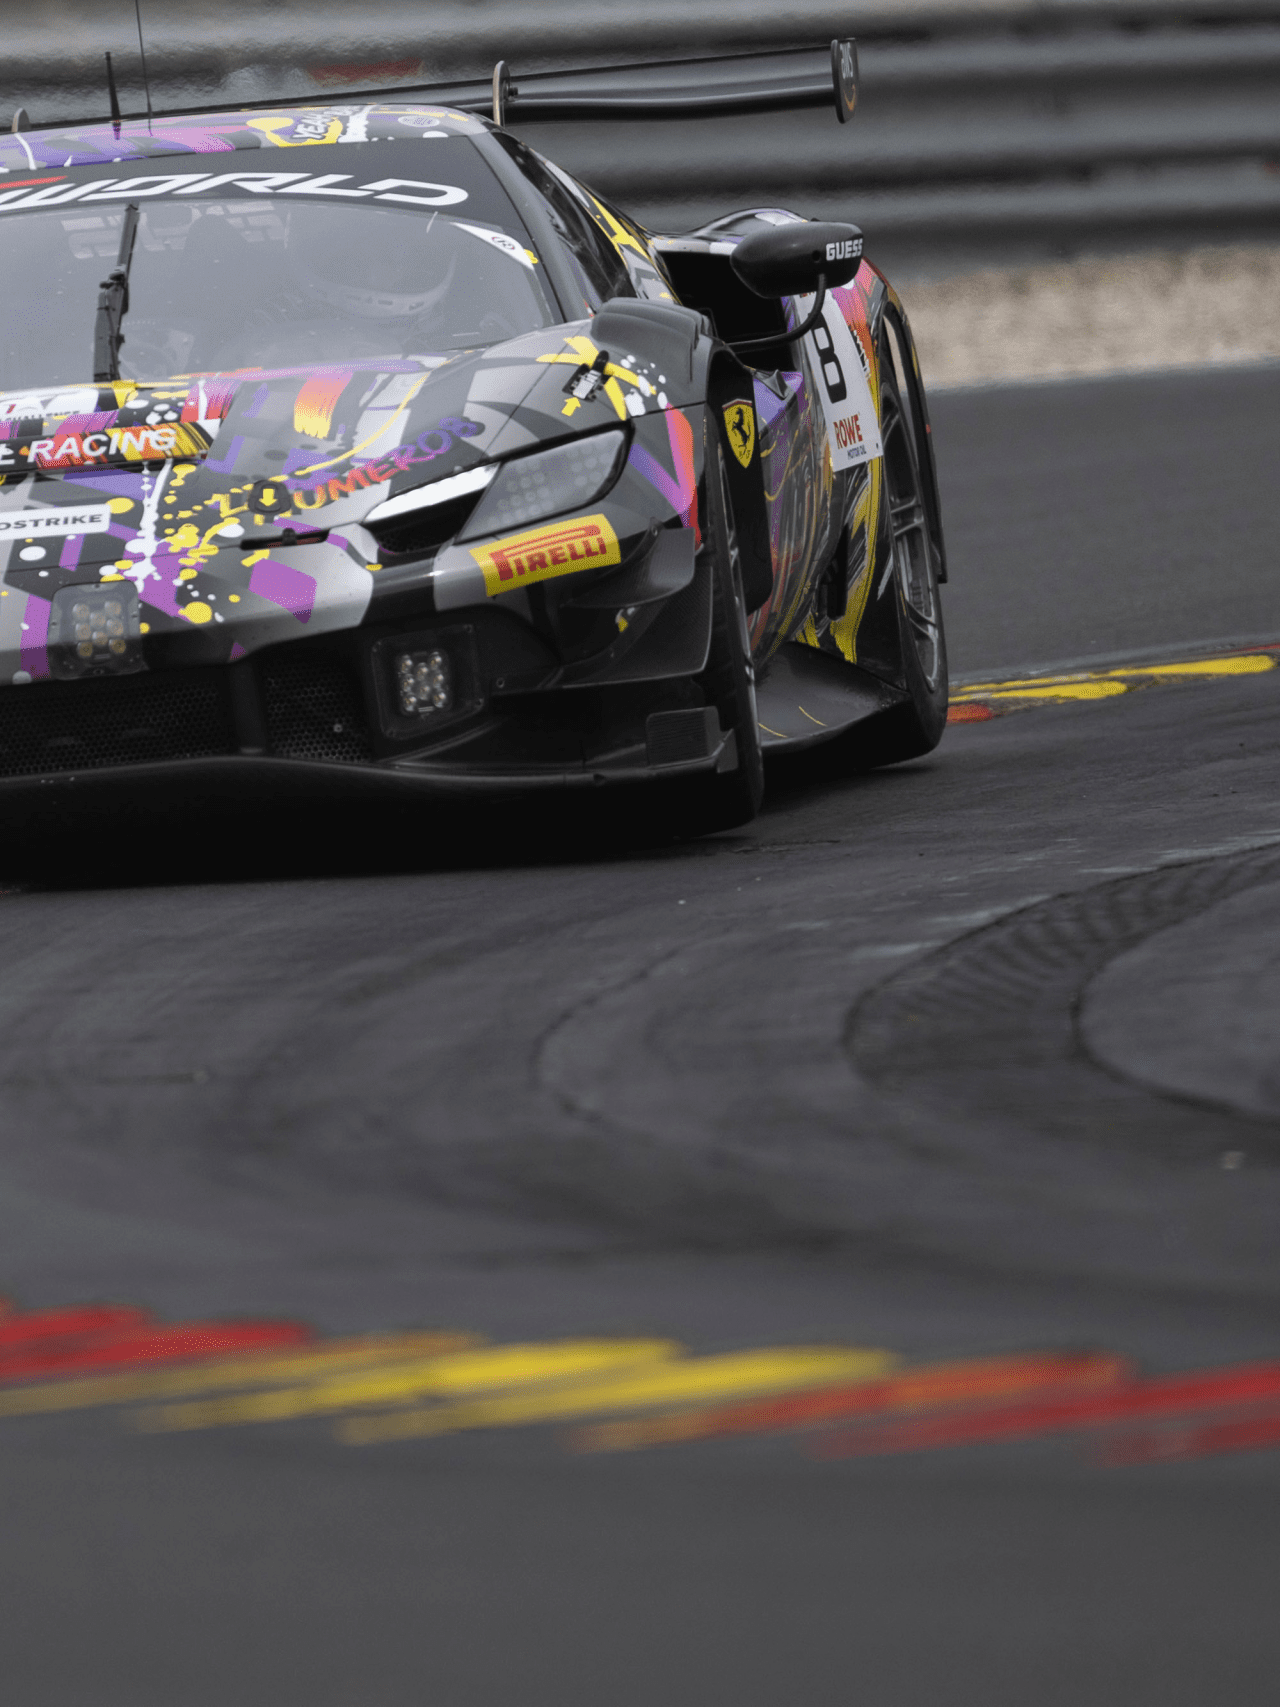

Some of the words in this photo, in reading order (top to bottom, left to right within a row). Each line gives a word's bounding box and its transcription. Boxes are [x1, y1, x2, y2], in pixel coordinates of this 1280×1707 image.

[826, 238, 863, 261] GUESS
[27, 428, 177, 464] RACING
[833, 414, 863, 449] ROWE
[489, 524, 607, 581] PIRELLI
